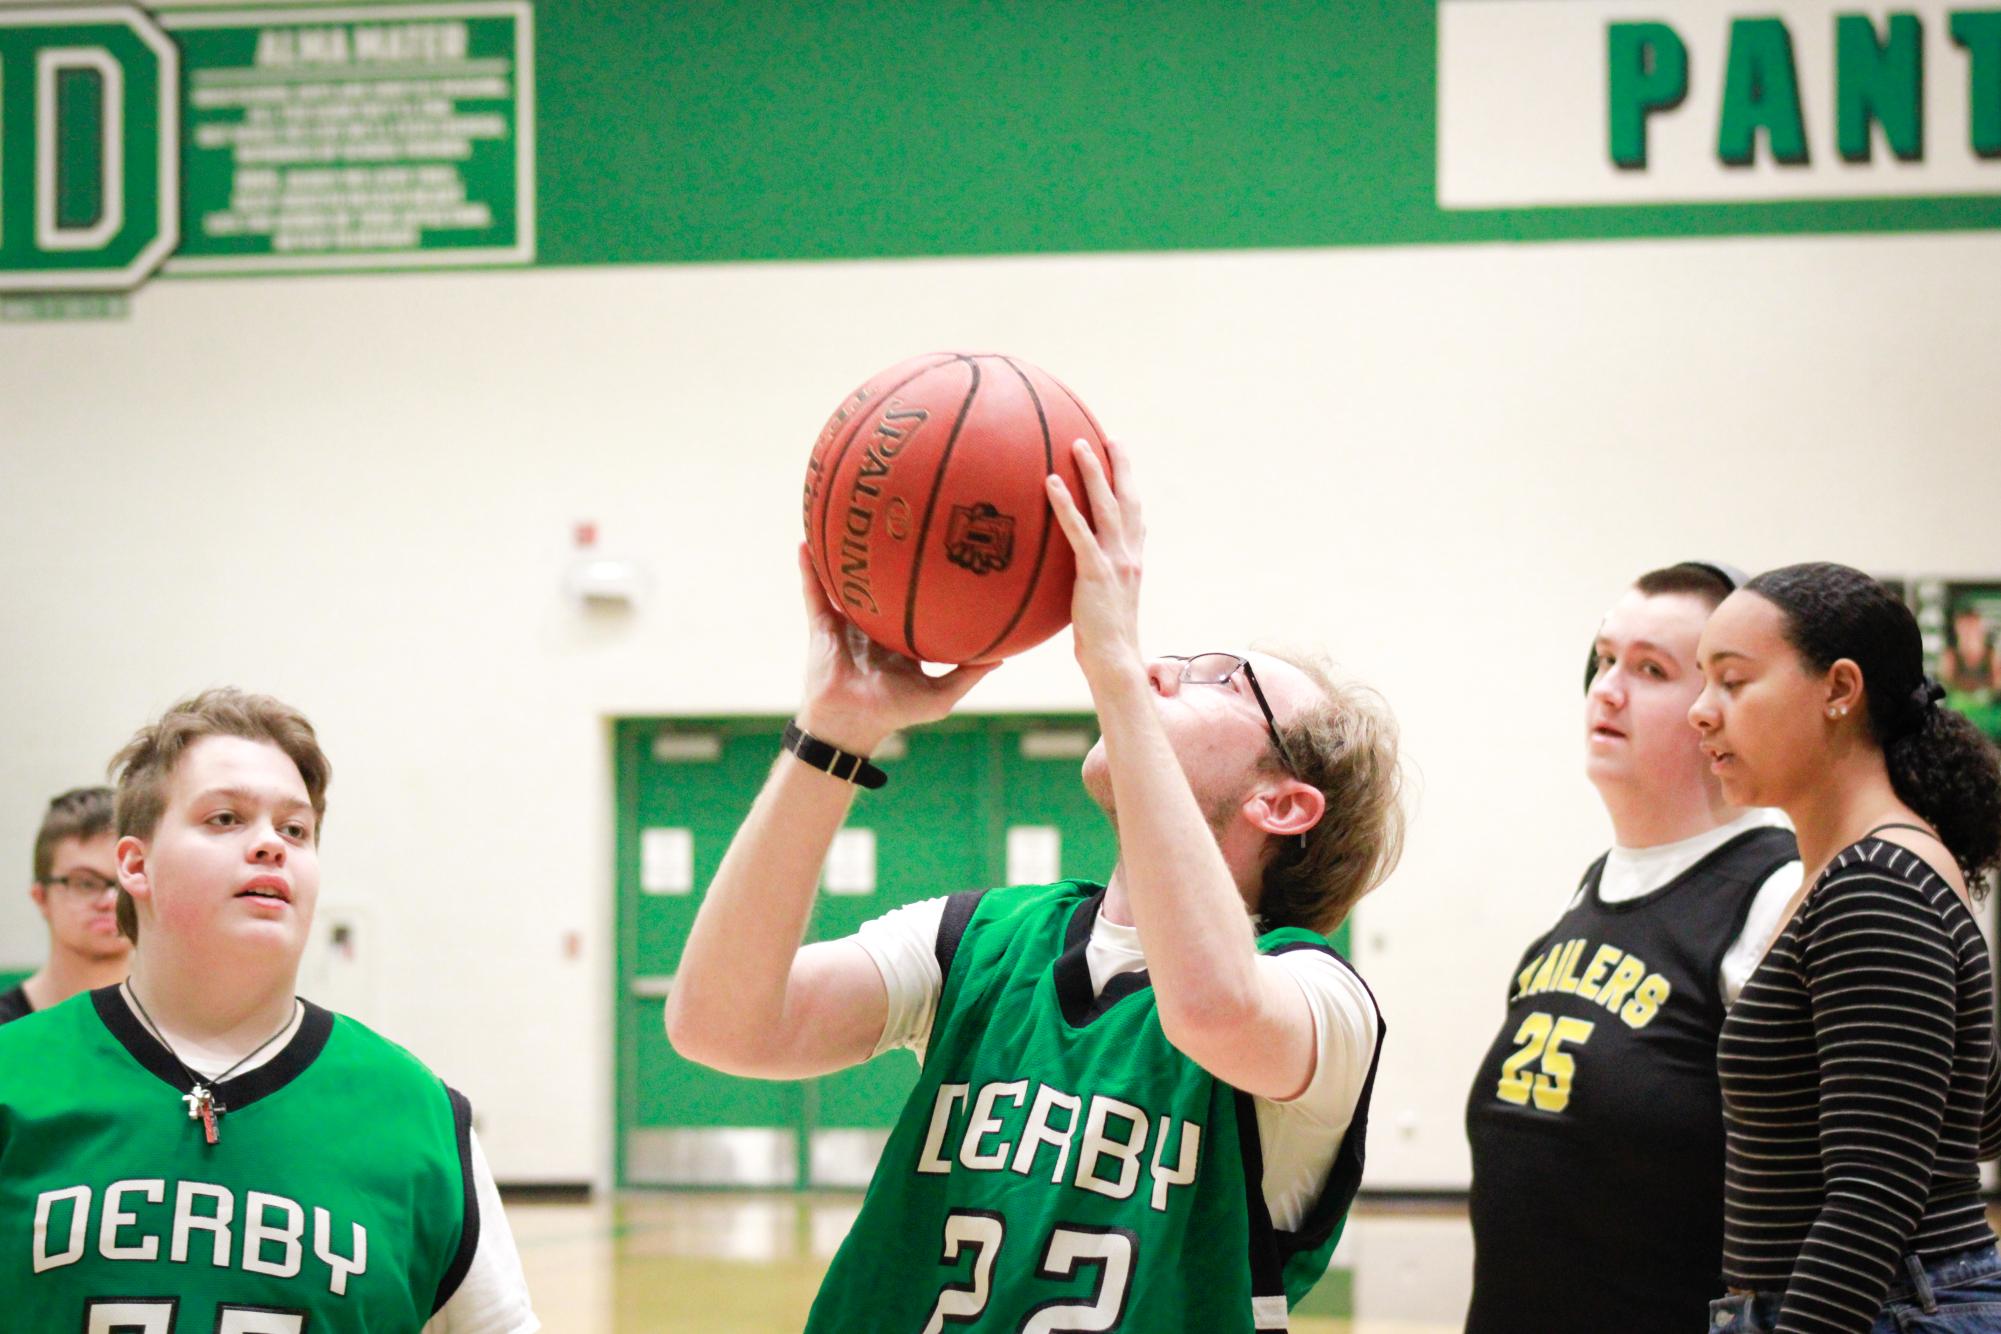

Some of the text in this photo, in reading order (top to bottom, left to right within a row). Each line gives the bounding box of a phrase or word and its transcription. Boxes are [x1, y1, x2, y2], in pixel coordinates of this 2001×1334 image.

[1606, 9, 2001, 171] PANT
[841, 397, 930, 616] SPALDING
[1496, 1011, 1595, 1113] 25
[33, 1178, 367, 1296] DERBY
[921, 1208, 1140, 1334] 22
